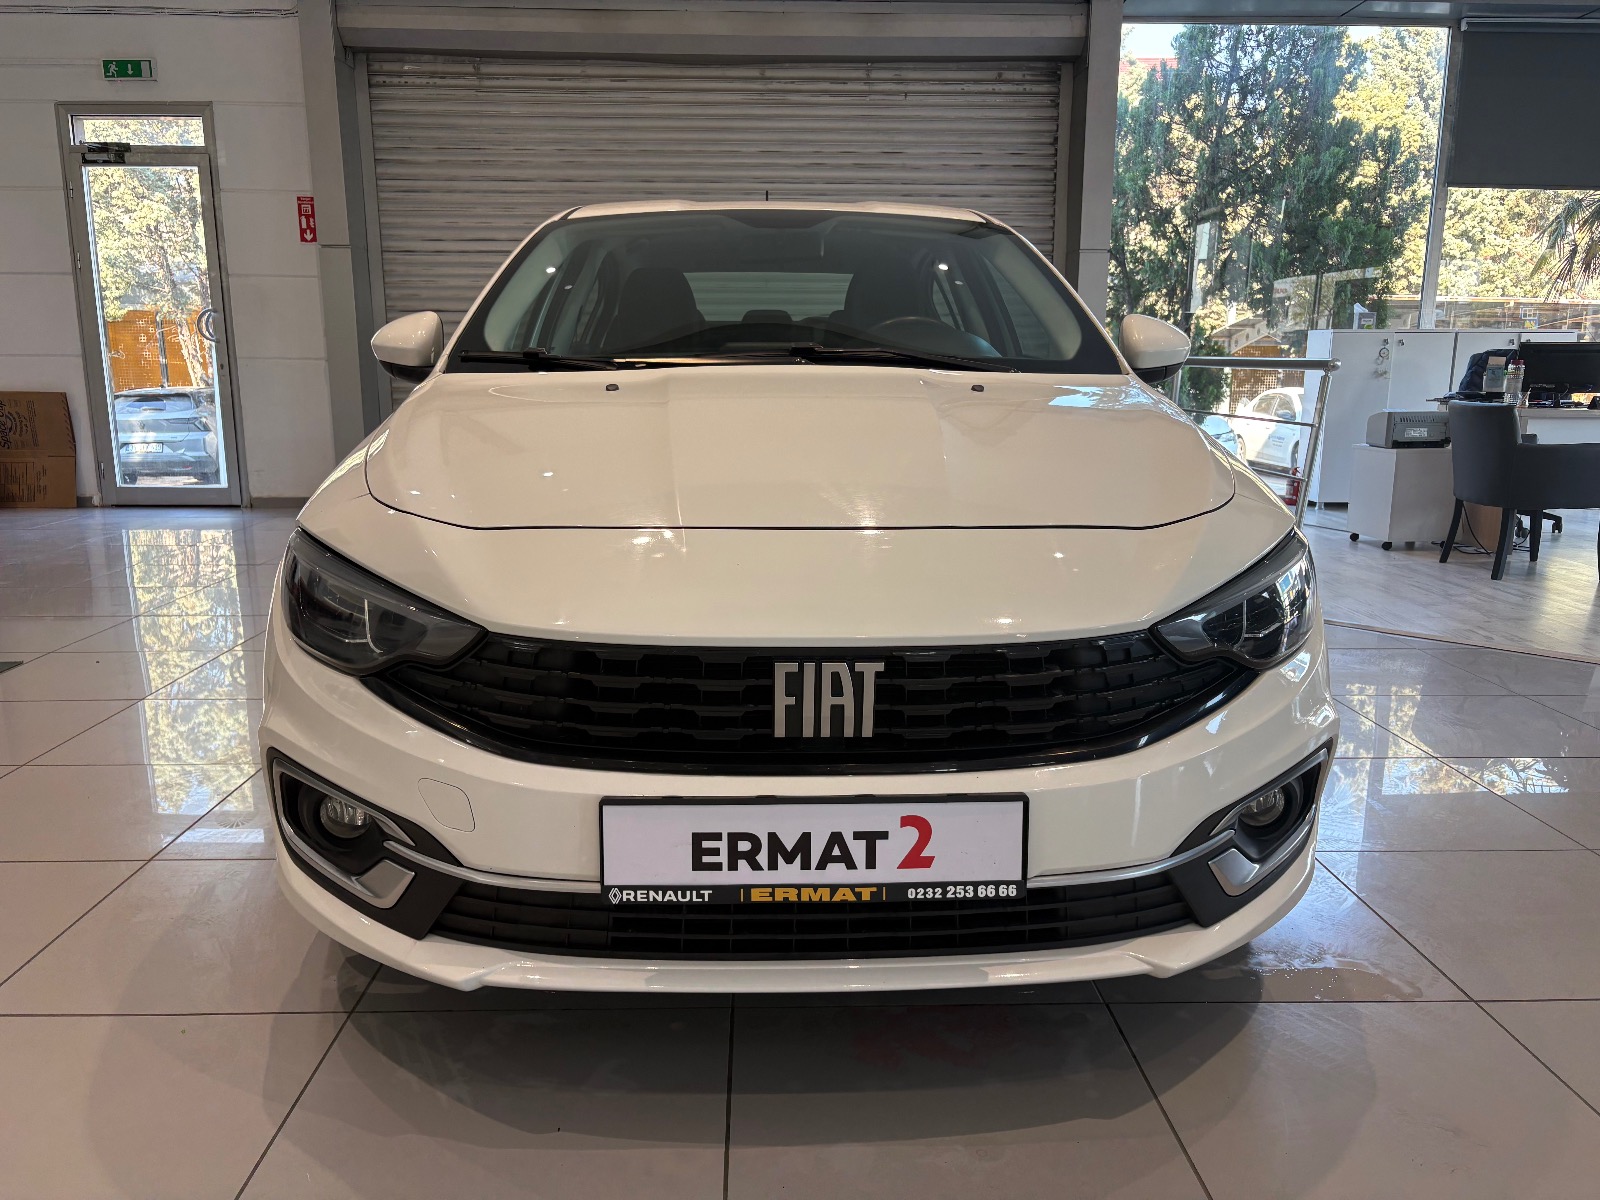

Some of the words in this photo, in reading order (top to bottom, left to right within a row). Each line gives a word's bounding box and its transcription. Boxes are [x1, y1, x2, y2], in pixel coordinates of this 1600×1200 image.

[774, 662, 885, 738] FIAT
[691, 831, 890, 872] ERMAT
[896, 814, 936, 870] 2
[622, 889, 713, 902] RENAULT
[750, 886, 878, 902] ERMAT
[907, 886, 943, 899] 0232
[946, 886, 975, 898] 253
[977, 885, 996, 897] 66
[998, 884, 1017, 897] 66
